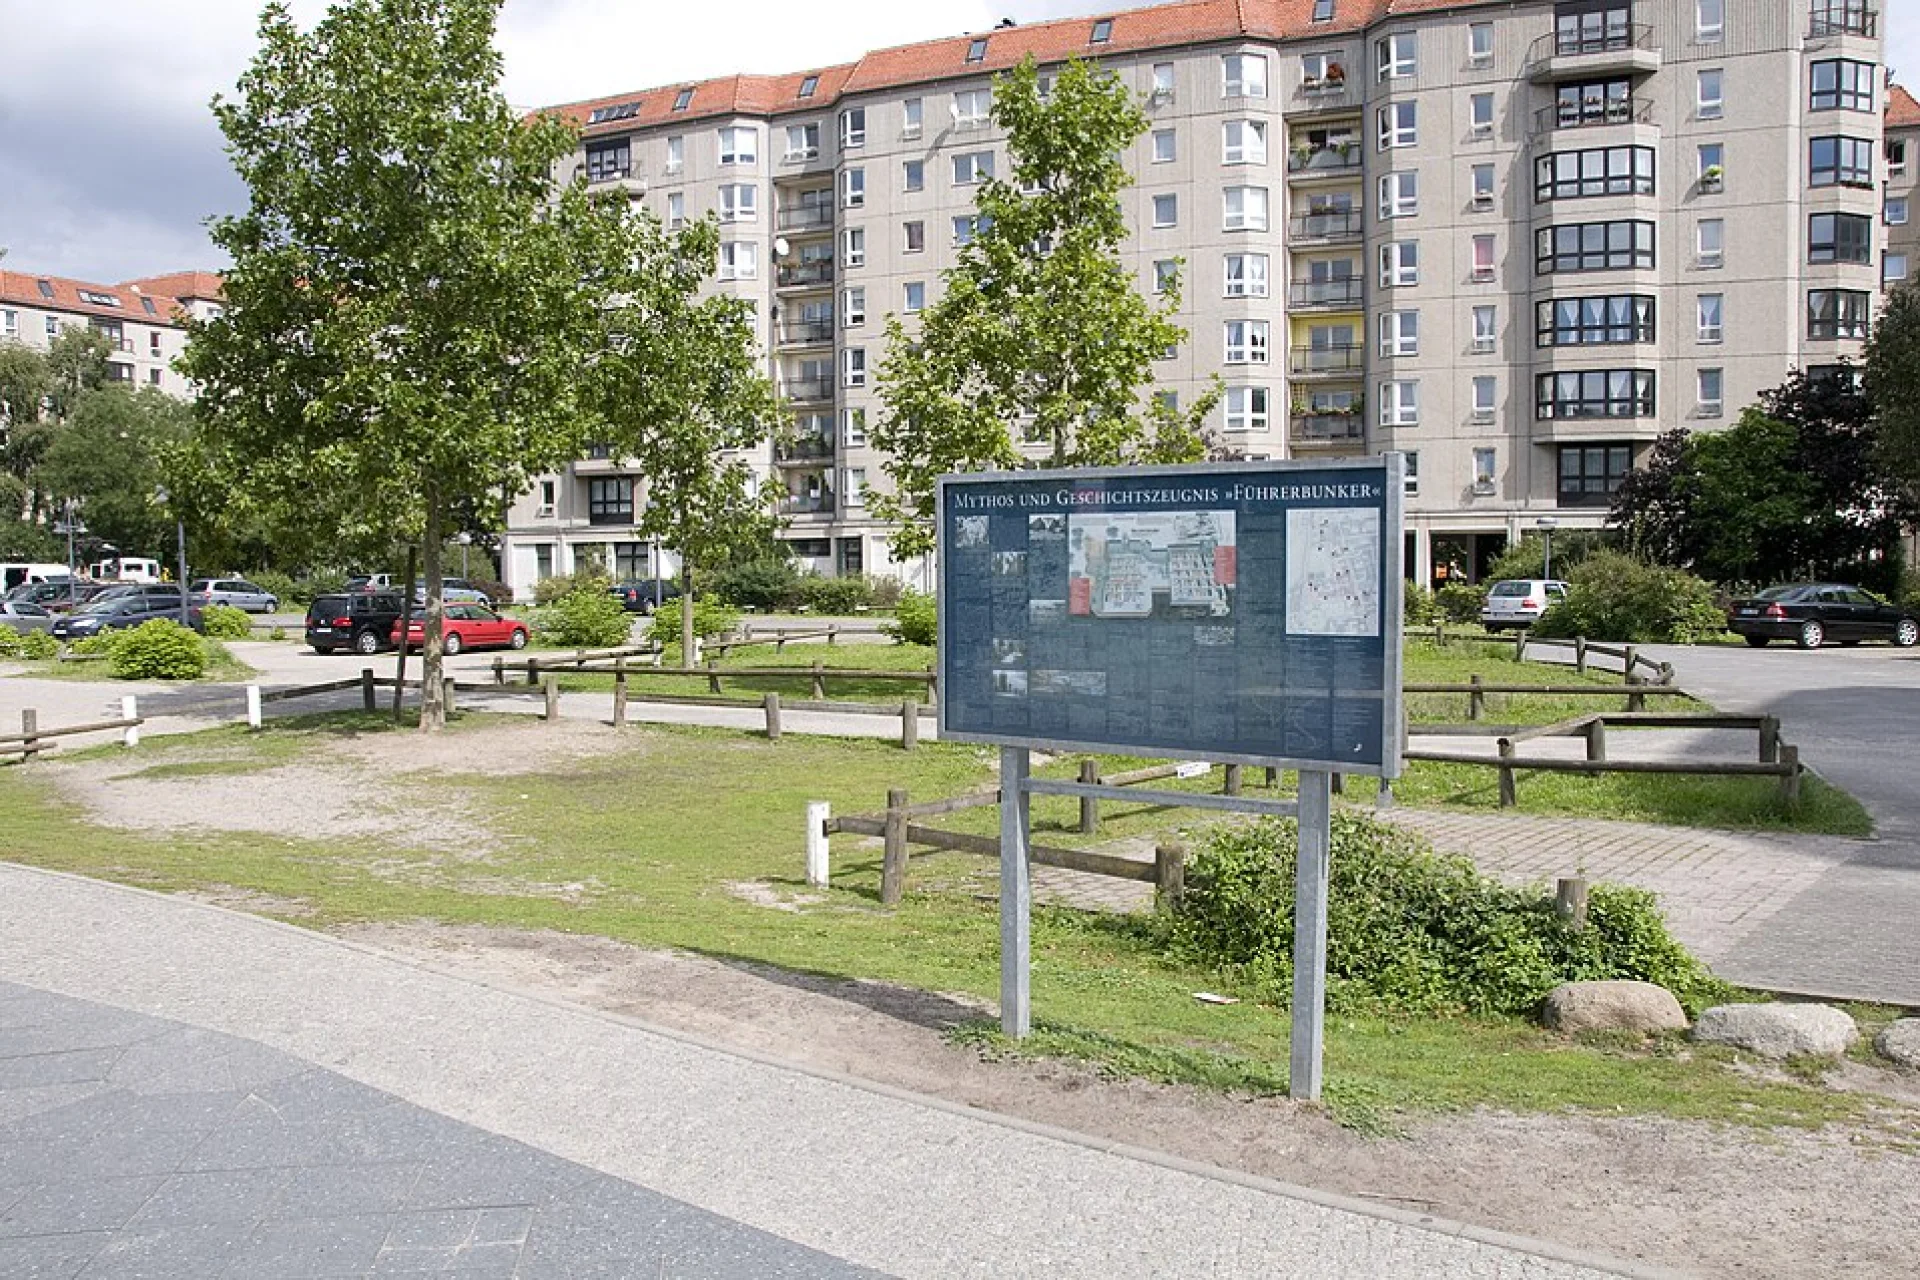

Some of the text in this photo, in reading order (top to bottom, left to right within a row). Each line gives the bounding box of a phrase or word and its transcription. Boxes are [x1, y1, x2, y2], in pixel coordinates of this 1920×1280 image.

[954, 492, 1014, 508] MYTHOS
[1020, 492, 1050, 506] UND
[1056, 487, 1219, 505] GESCHICHTSZEUGNIS
